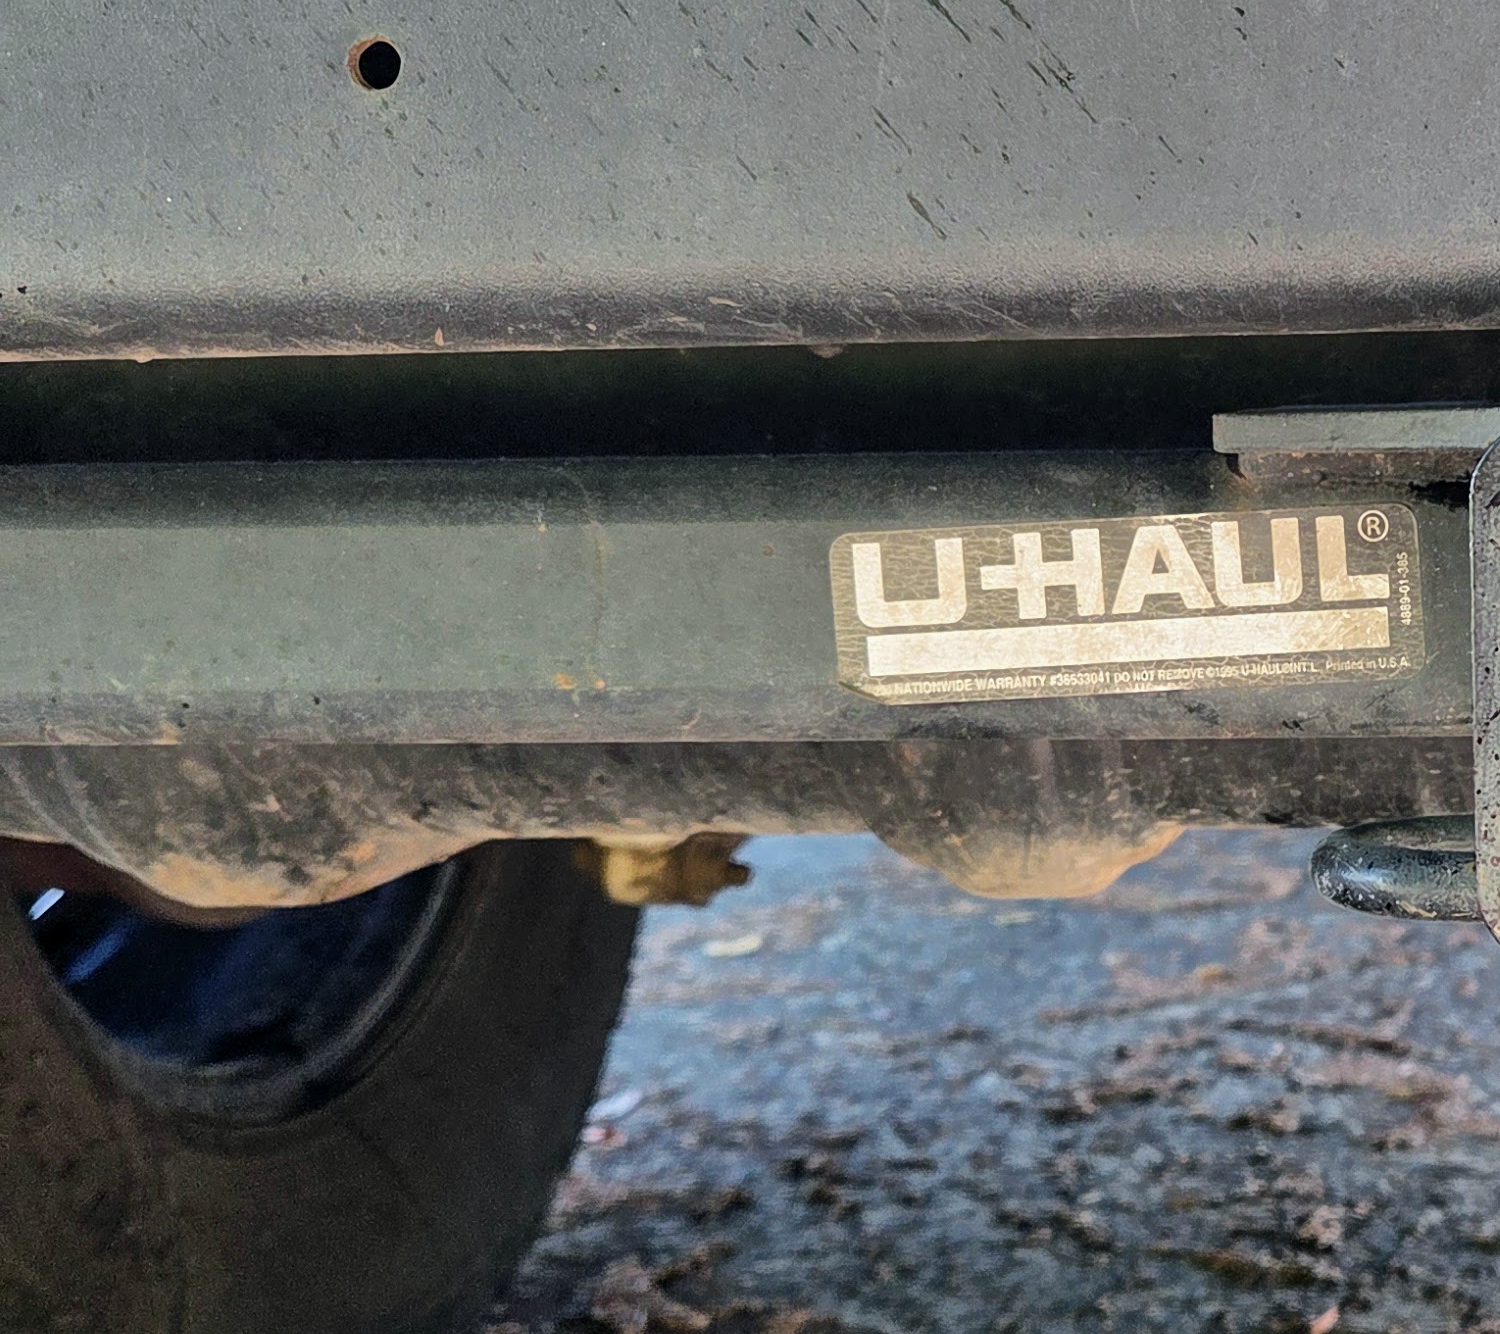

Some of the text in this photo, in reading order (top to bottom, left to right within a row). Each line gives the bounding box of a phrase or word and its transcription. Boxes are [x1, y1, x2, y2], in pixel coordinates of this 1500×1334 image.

[893, 677, 974, 695] NATIONWIDE
[975, 674, 1046, 691] WARRANTY
[1113, 671, 1131, 684] DO
[1133, 669, 1155, 682] NOT
[1325, 659, 1363, 671] Printed
[1366, 659, 1376, 670] in
